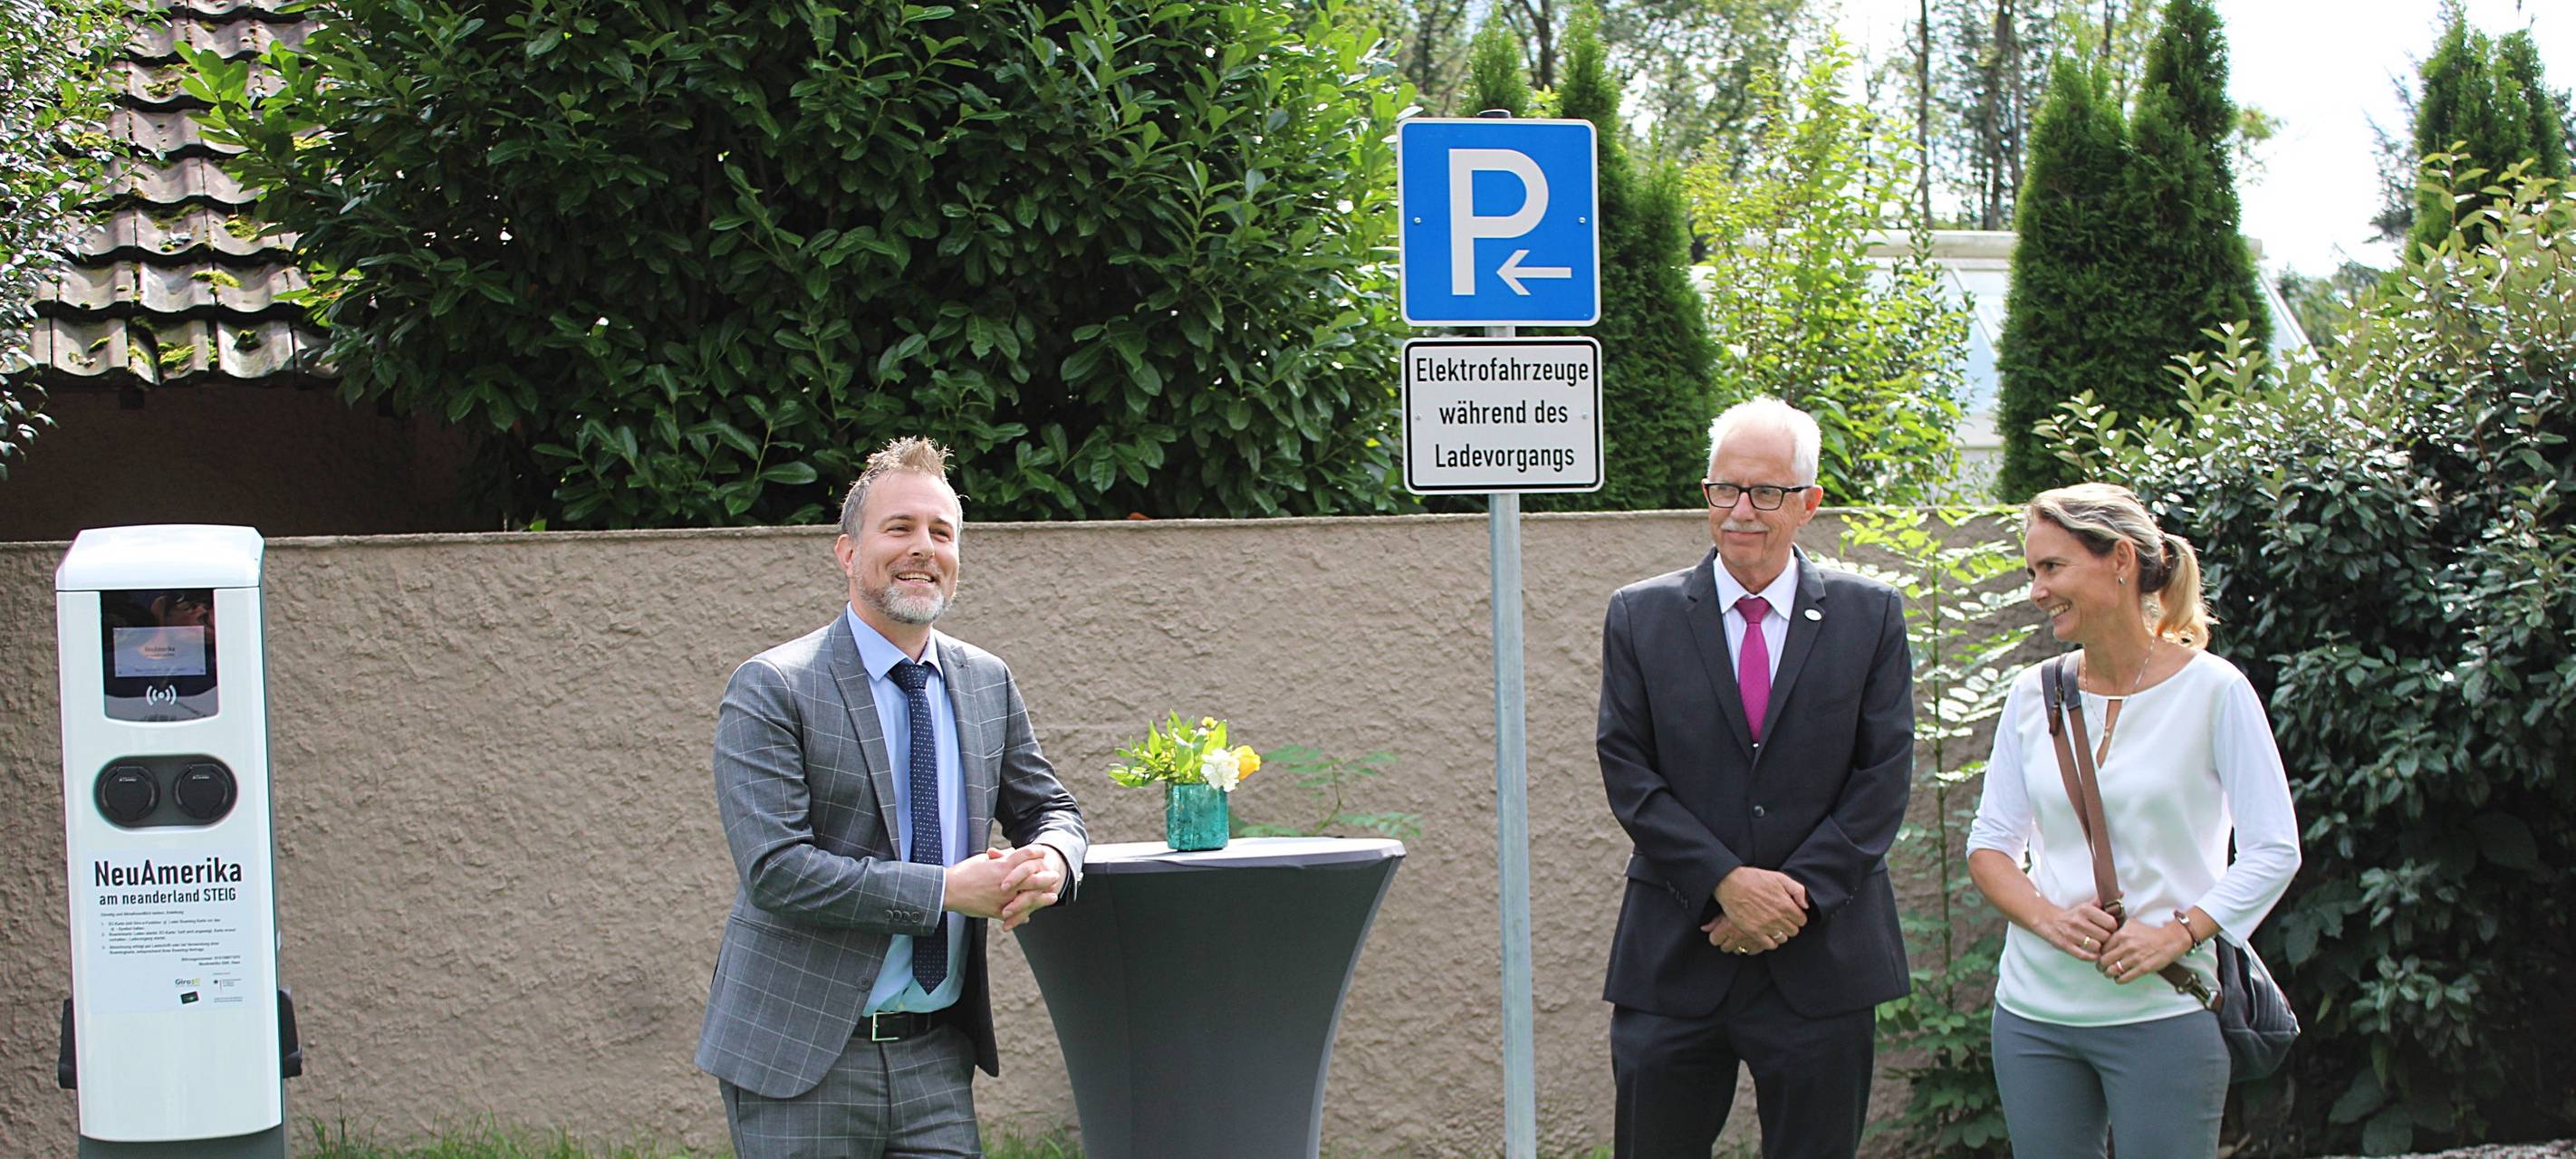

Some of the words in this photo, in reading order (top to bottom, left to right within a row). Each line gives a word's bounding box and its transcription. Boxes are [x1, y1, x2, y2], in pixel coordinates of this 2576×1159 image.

[1448, 148, 1550, 296] P
[1416, 357, 1590, 388] Elektrofahrzeuge
[1438, 399, 1526, 425] während
[1534, 399, 1569, 424] des
[1435, 443, 1575, 473] Ladevorgangs
[94, 857, 242, 887] NeuAmerika
[99, 894, 118, 905] am
[121, 890, 200, 905] neanderland
[203, 887, 237, 902] STEIG
